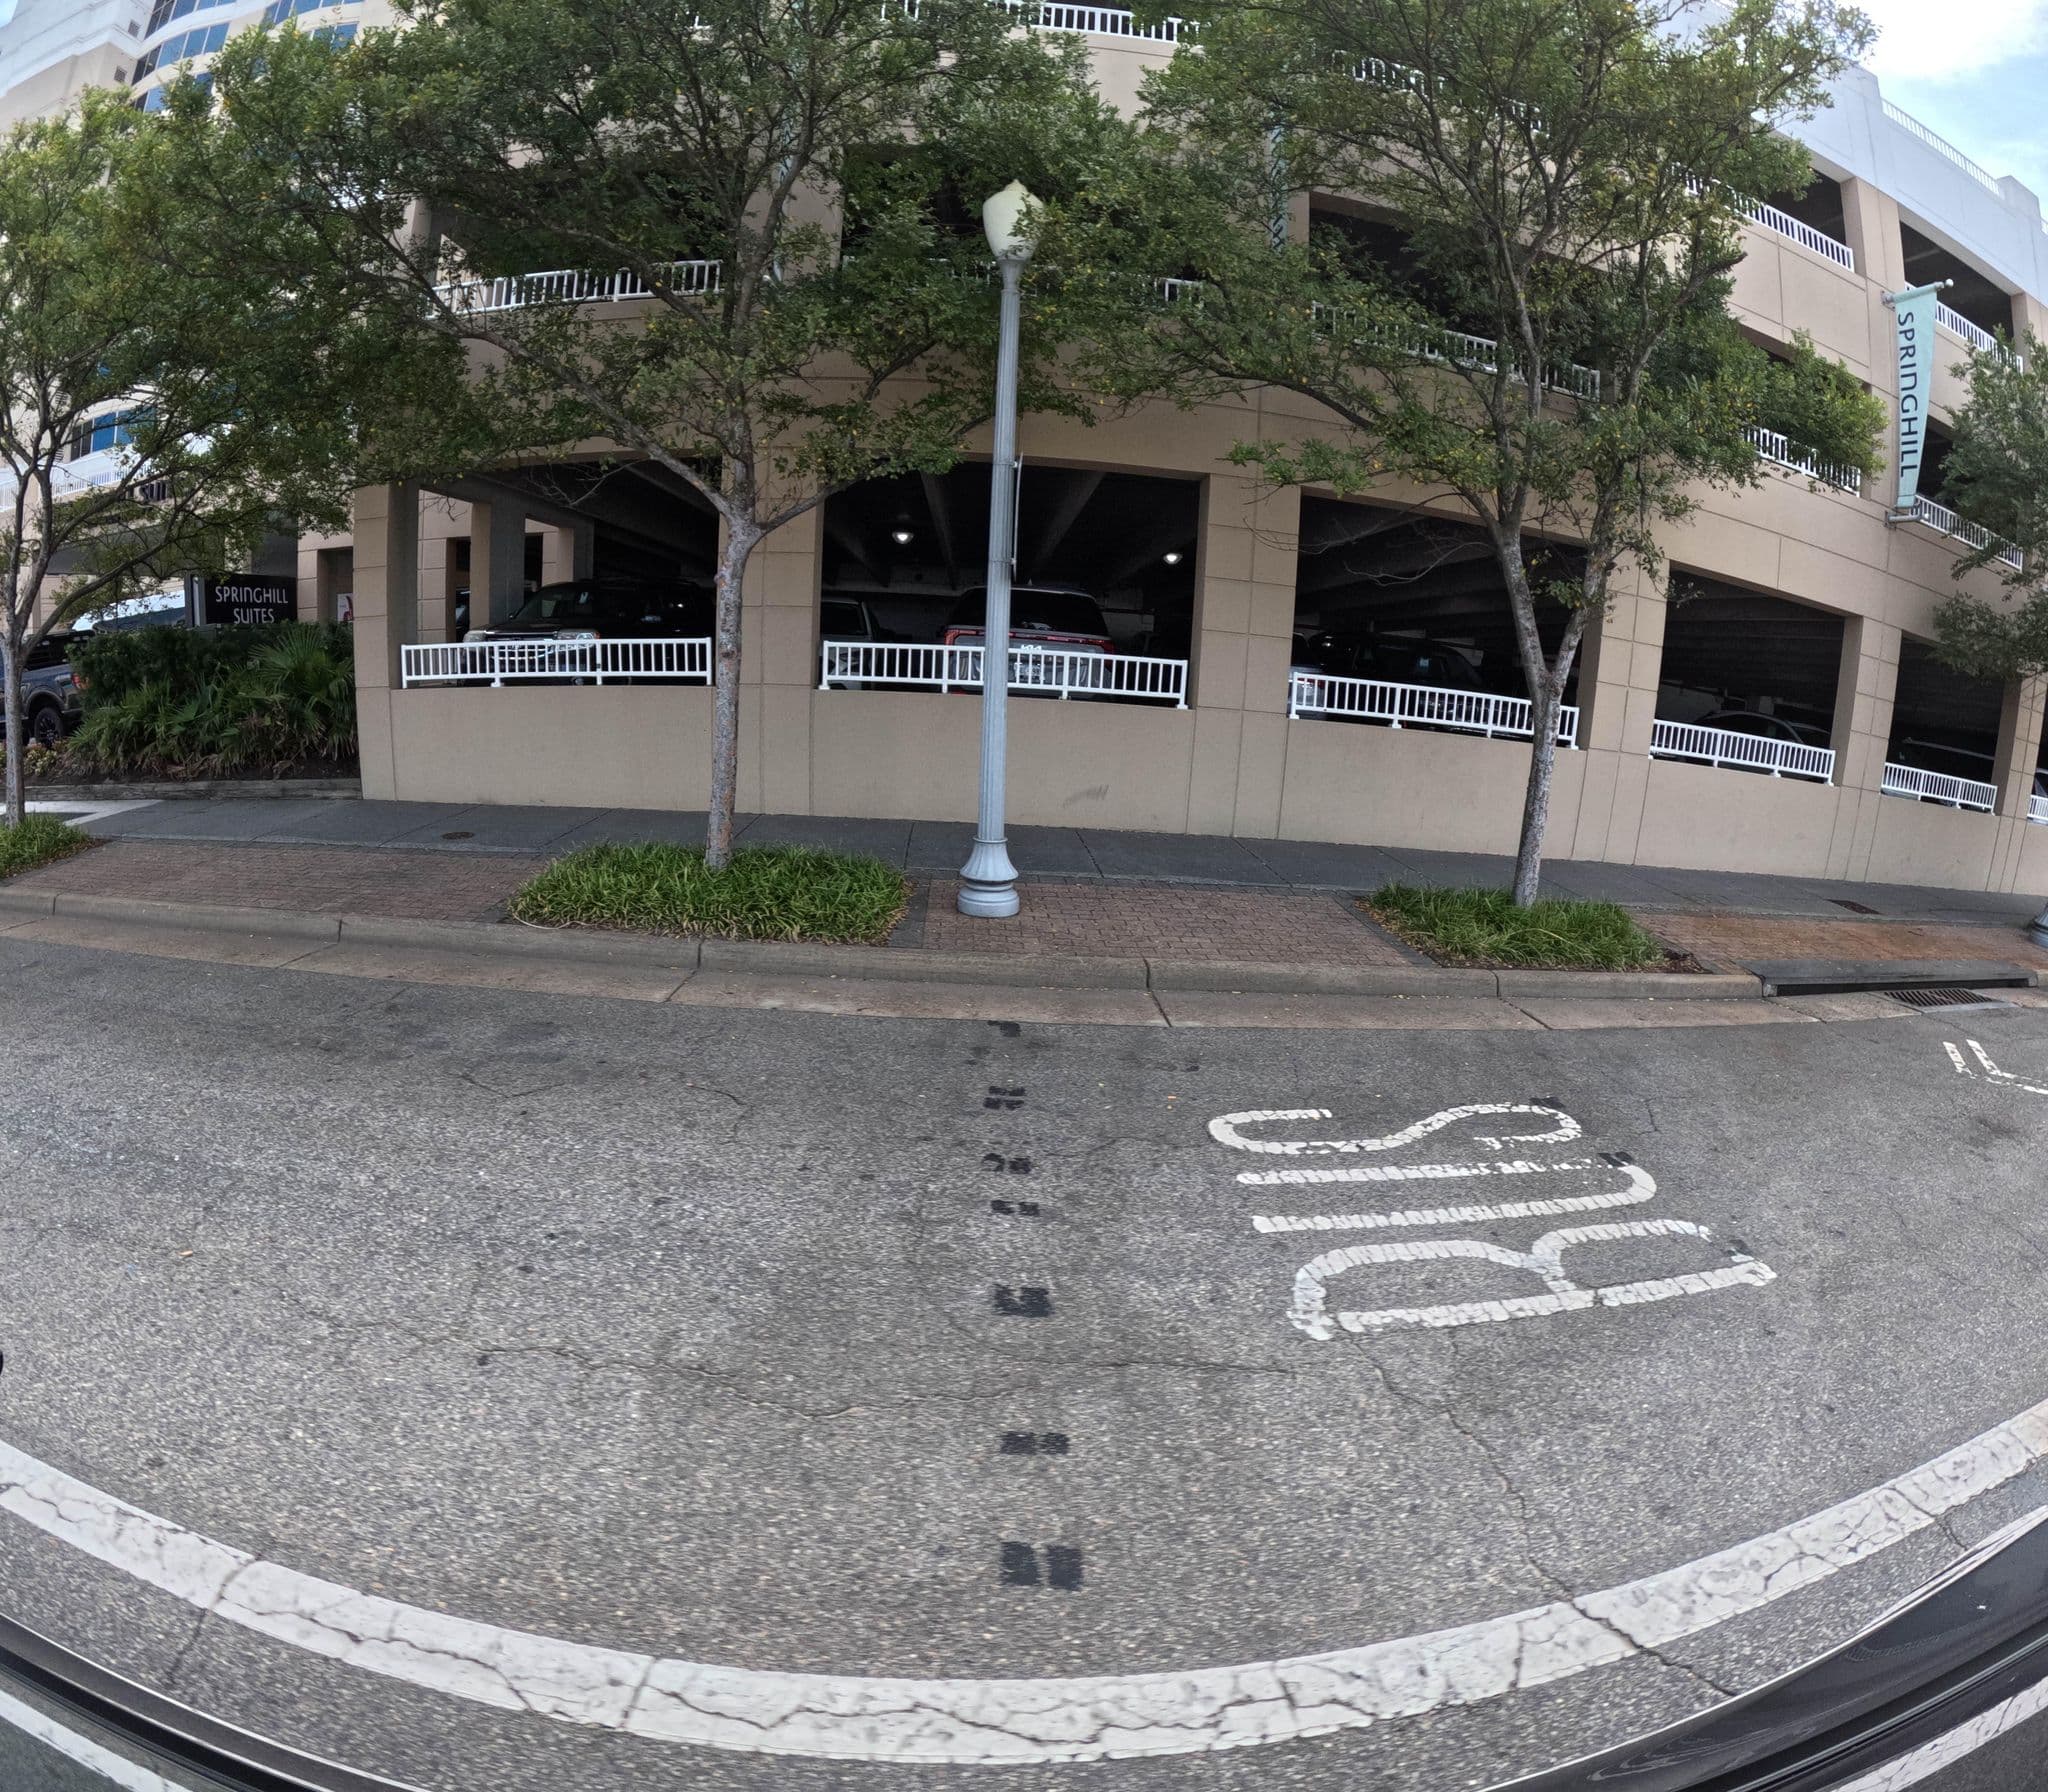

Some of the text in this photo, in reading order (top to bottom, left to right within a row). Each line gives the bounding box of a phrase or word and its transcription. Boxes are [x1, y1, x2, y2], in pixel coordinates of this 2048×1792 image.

[1897, 311, 1919, 478] SPRINGHILL
[215, 586, 289, 604] SPRINGHILL
[233, 608, 275, 625] SUITES
[1208, 1103, 1777, 1340] BUS
